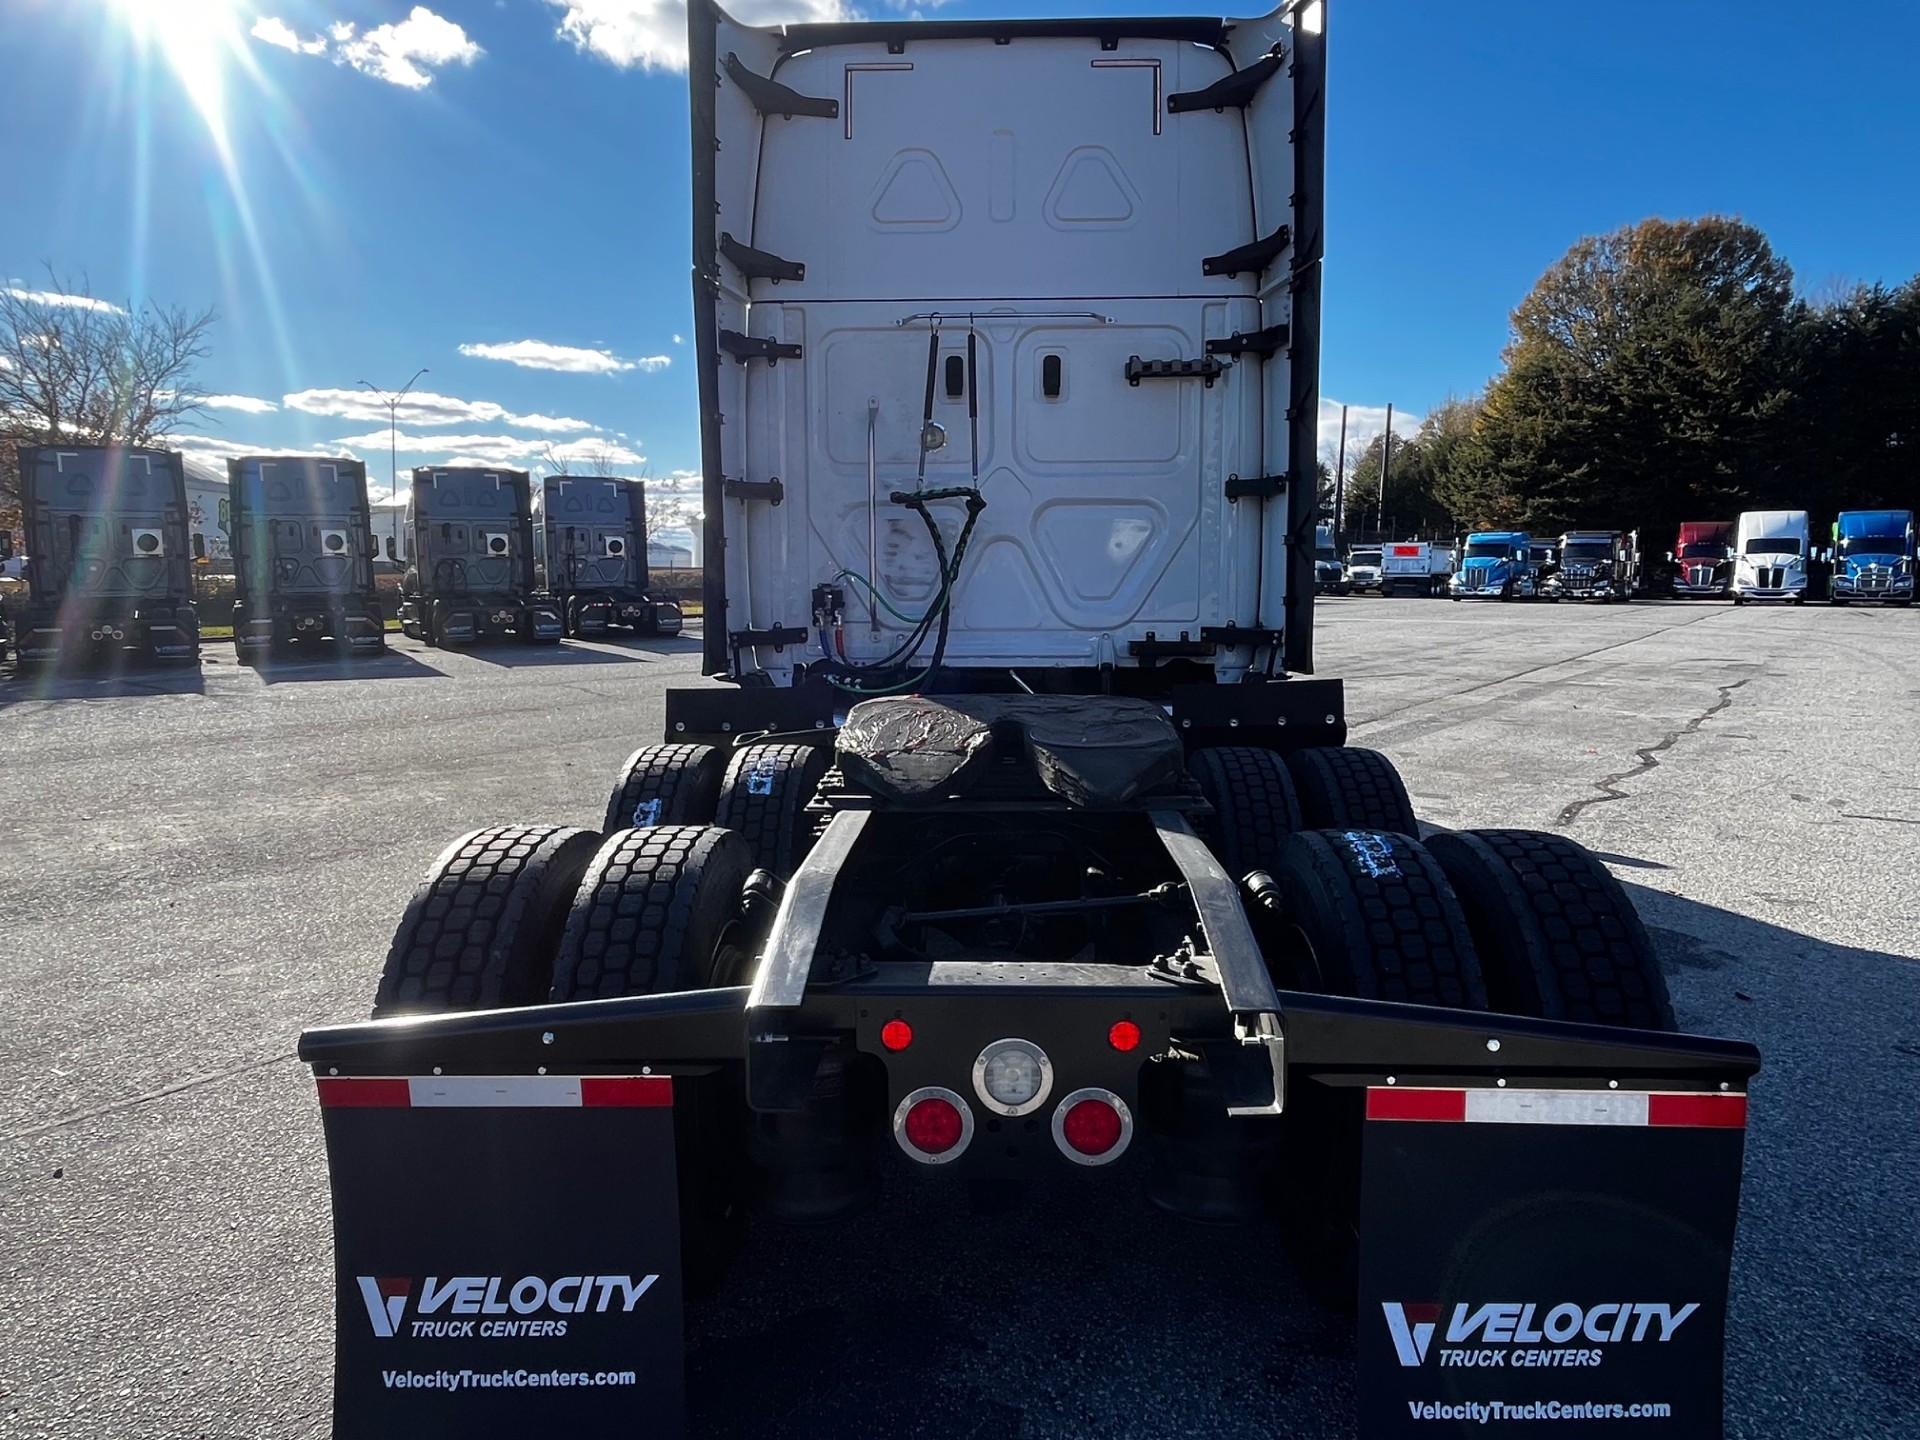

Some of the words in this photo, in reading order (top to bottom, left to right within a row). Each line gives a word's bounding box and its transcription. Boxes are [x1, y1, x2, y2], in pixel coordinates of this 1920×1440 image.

[418, 1274, 659, 1314] VELOCITY
[411, 1320, 474, 1338] TRUCK
[480, 1320, 567, 1338] CENTERS
[1446, 1302, 1700, 1343] VELOCITY
[1440, 1349, 1505, 1367] TRUCK
[1511, 1349, 1602, 1367] CENTERS
[383, 1370, 636, 1392] VelocityTruckCenters.com
[1408, 1400, 1671, 1424] VelocityTruckCenters.com
